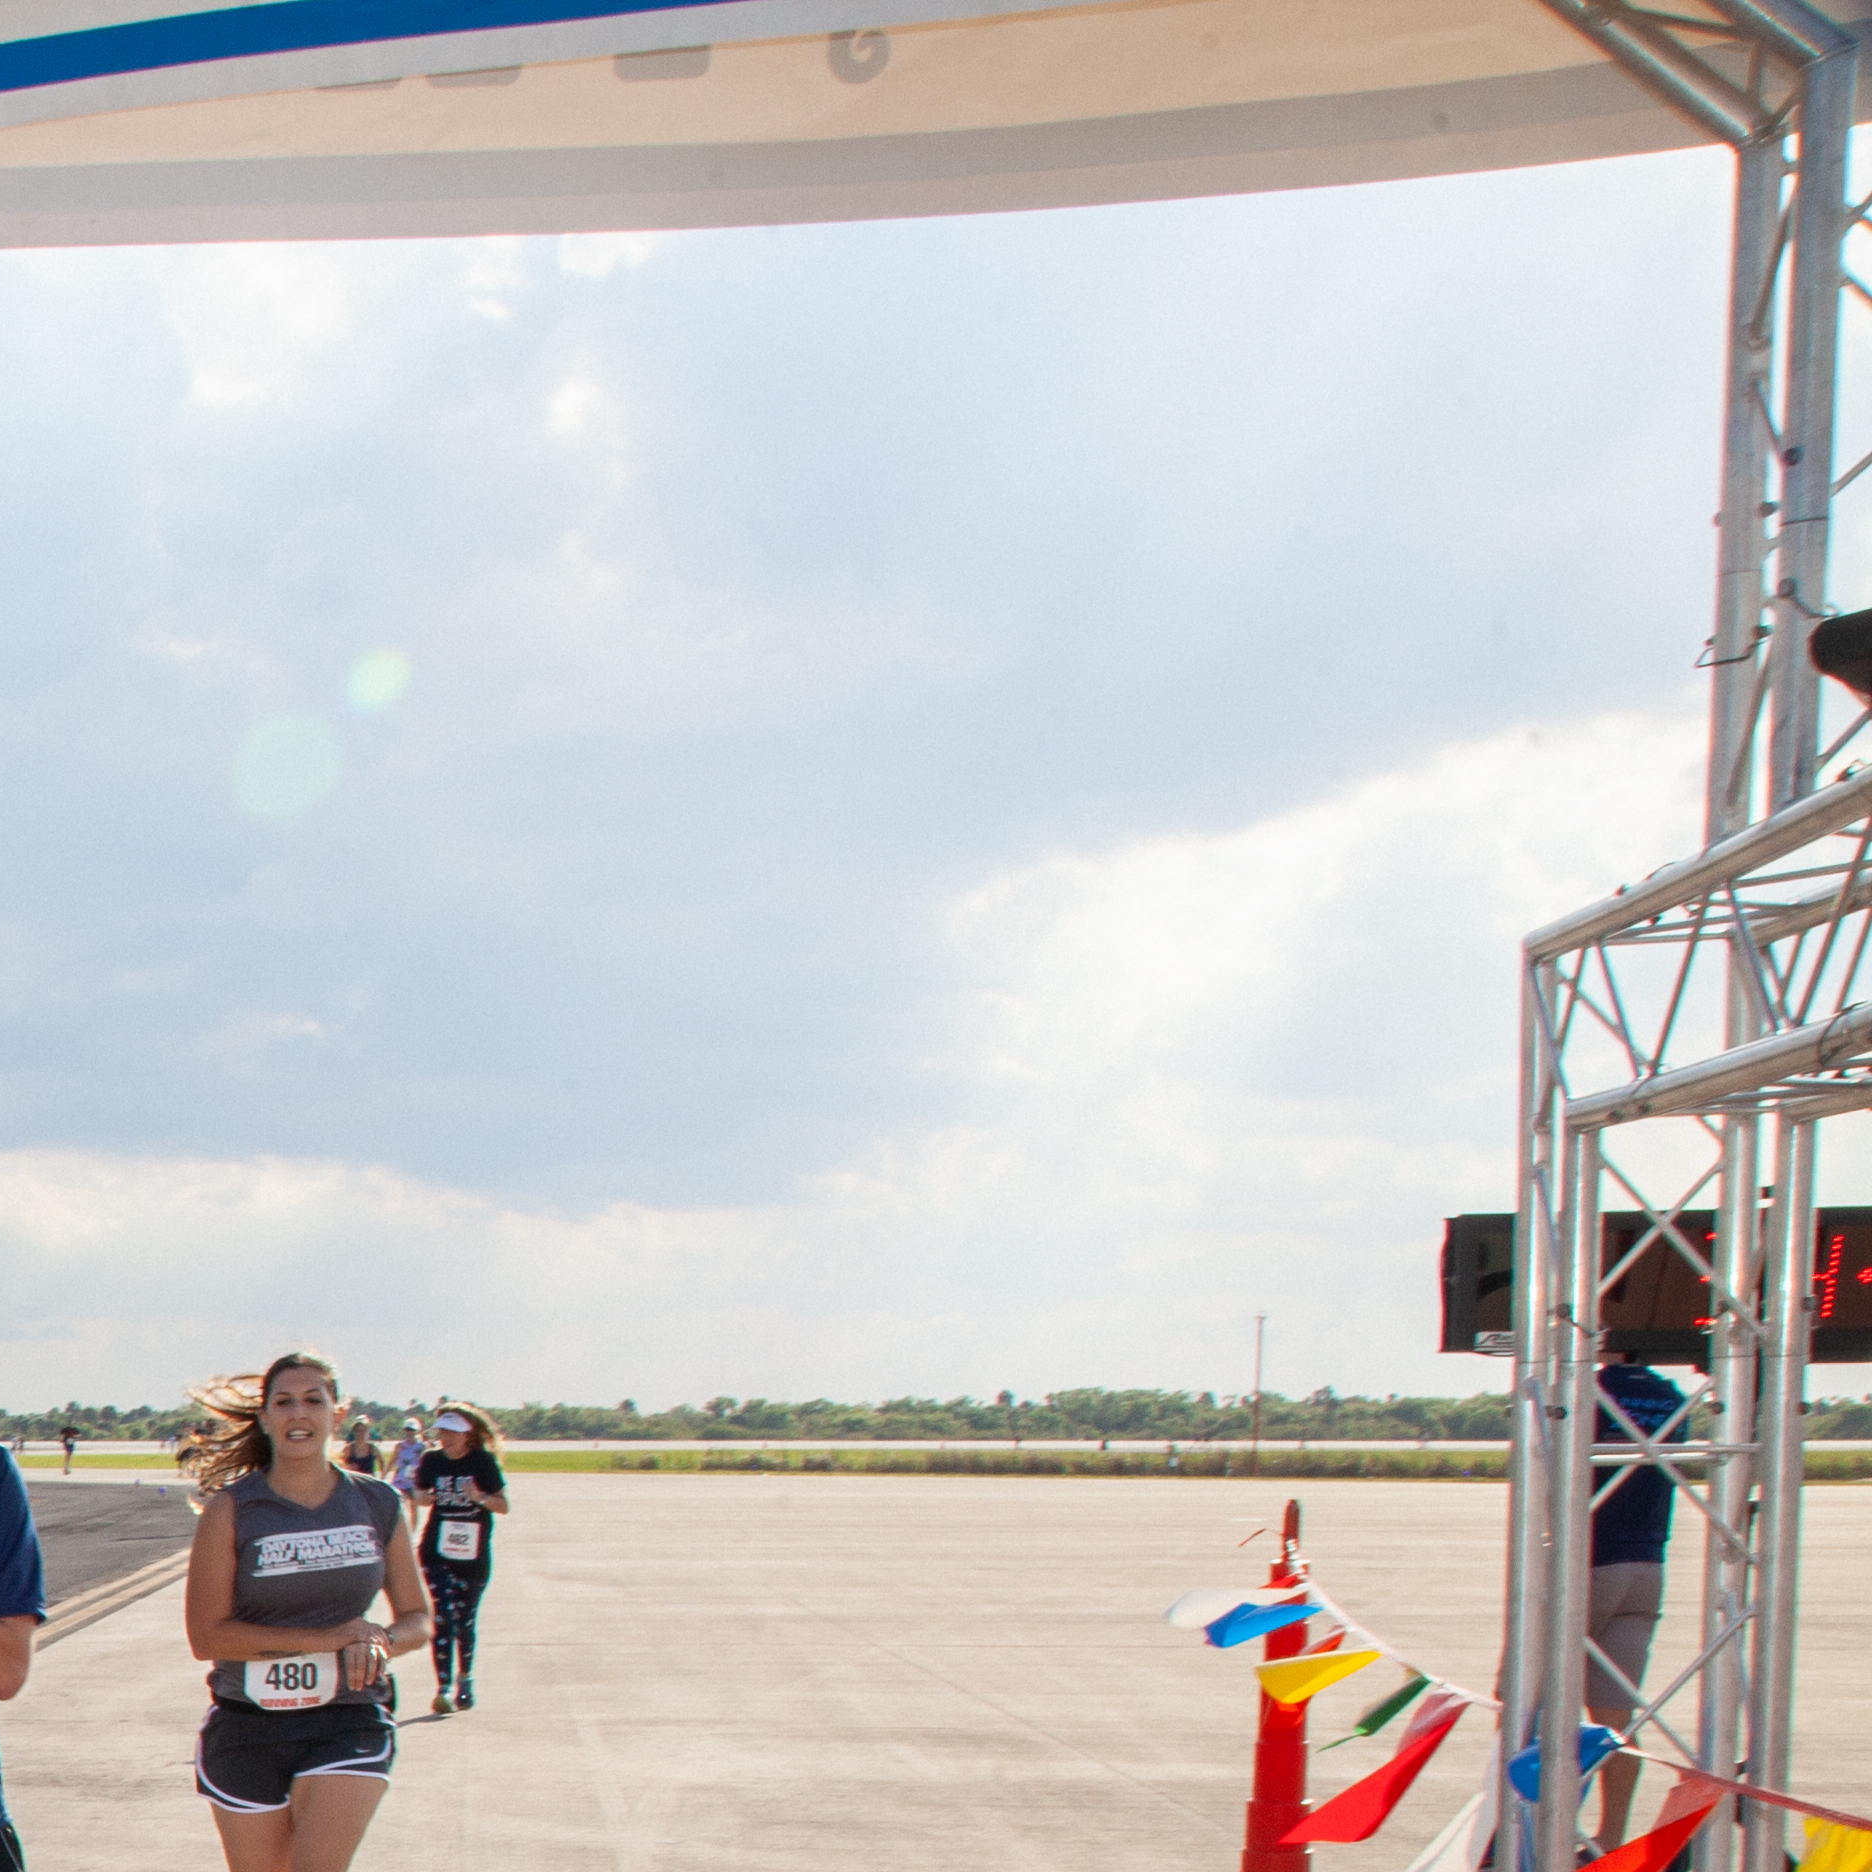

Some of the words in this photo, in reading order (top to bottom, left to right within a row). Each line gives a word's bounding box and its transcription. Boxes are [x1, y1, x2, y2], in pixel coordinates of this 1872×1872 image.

[258, 1550, 296, 1566] HALF
[297, 1540, 377, 1561] MARATHON
[261, 1536, 327, 1553] DAYTONA
[265, 1662, 318, 1690] 480
